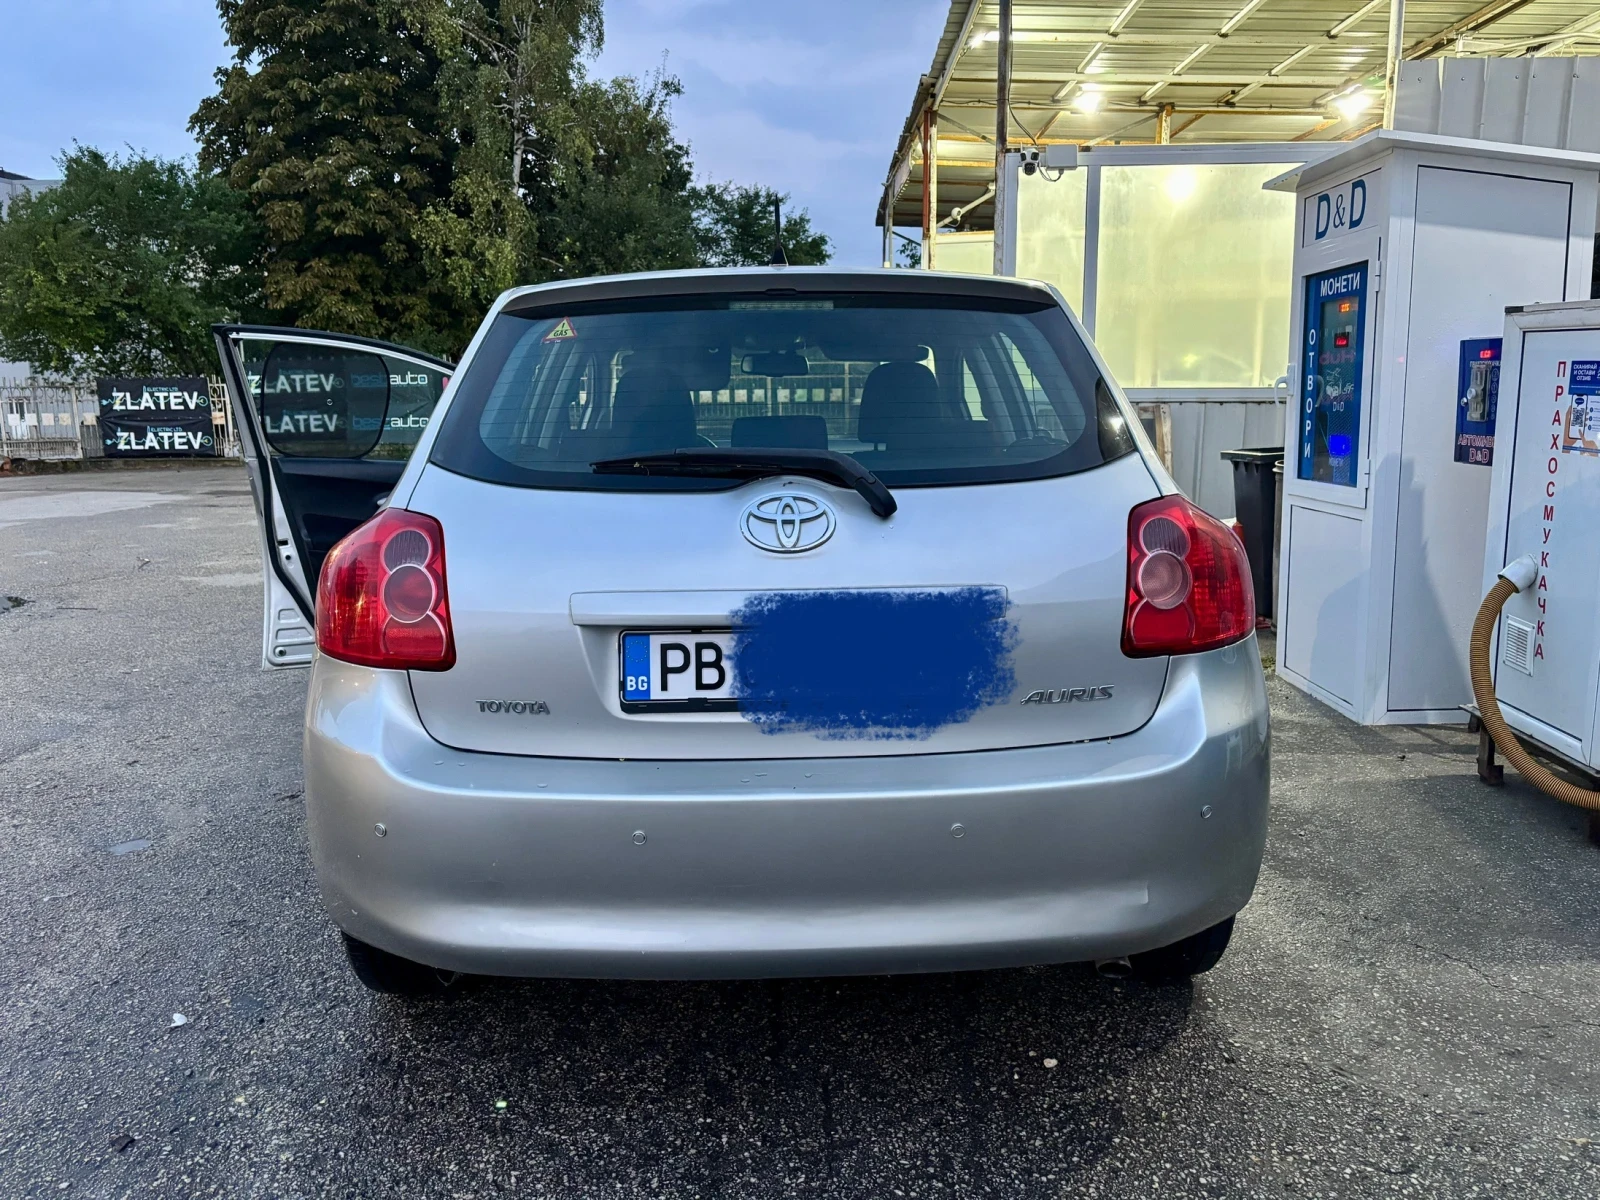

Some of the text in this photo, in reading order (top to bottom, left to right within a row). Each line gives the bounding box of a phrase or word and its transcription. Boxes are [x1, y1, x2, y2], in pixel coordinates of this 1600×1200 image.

[1314, 178, 1367, 241] D&D
[1320, 272, 1361, 297] МОНЕТИ
[553, 329, 569, 337] GAS
[112, 391, 198, 410] ZLATEV
[1304, 328, 1316, 458] ОТВОРИ
[259, 413, 338, 434] LATEV
[116, 431, 203, 450] ZLATEV
[1458, 433, 1495, 448] АВТОМИВ
[1469, 447, 1490, 464] D&D
[1535, 361, 1566, 660] ПРАХОСМУКАЧКА
[626, 675, 648, 691] BG
[1020, 684, 1115, 705] AURIS
[476, 699, 551, 716] TOYOTA
